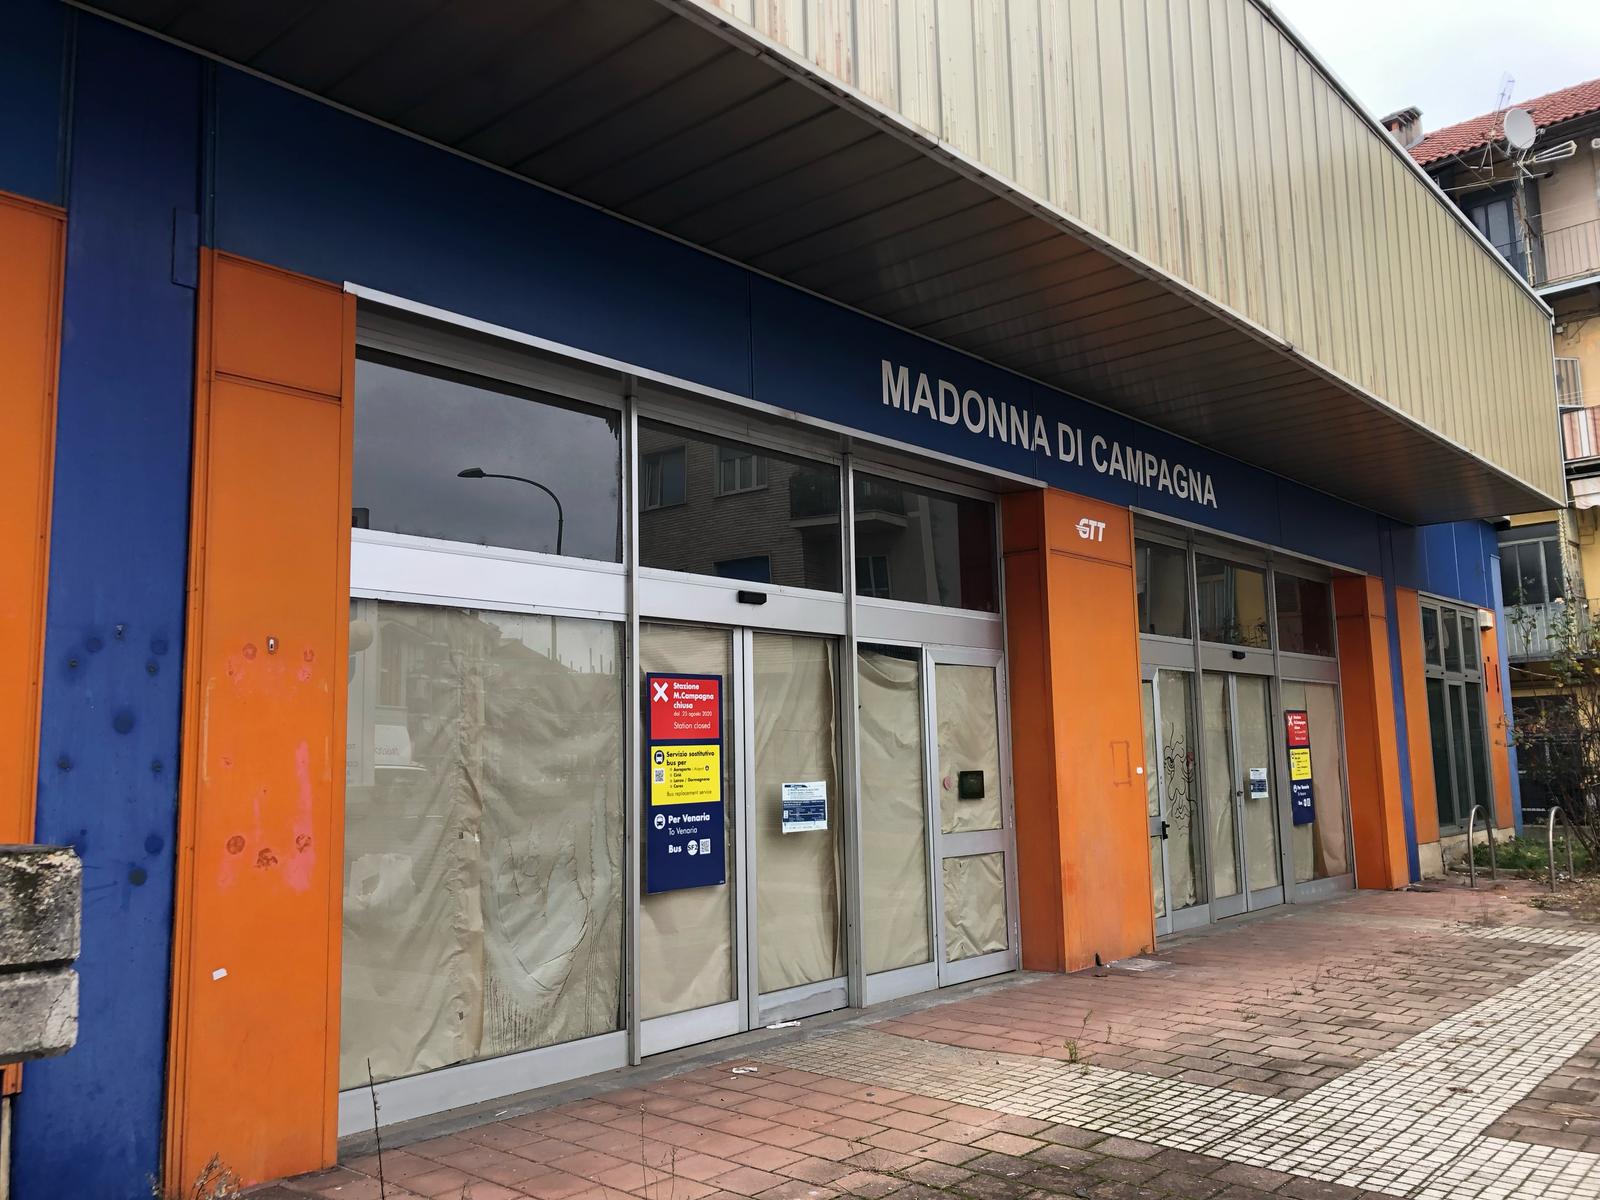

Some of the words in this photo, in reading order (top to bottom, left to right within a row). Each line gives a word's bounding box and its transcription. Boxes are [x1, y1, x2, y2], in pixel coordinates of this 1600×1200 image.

[881, 359, 1051, 457] MADONNA
[1057, 422, 1083, 466] DI
[1091, 435, 1218, 509] CAMPAGNA
[1074, 518, 1106, 542] GTT
[673, 682, 700, 690] Stazione
[673, 692, 714, 702] M.Campagna
[673, 721, 692, 729] Station
[694, 721, 711, 729] closed
[668, 815, 681, 824] Per
[682, 812, 711, 822] Venaria
[668, 828, 675, 836] To
[676, 826, 698, 835] Venaria
[668, 844, 682, 854] Bus
